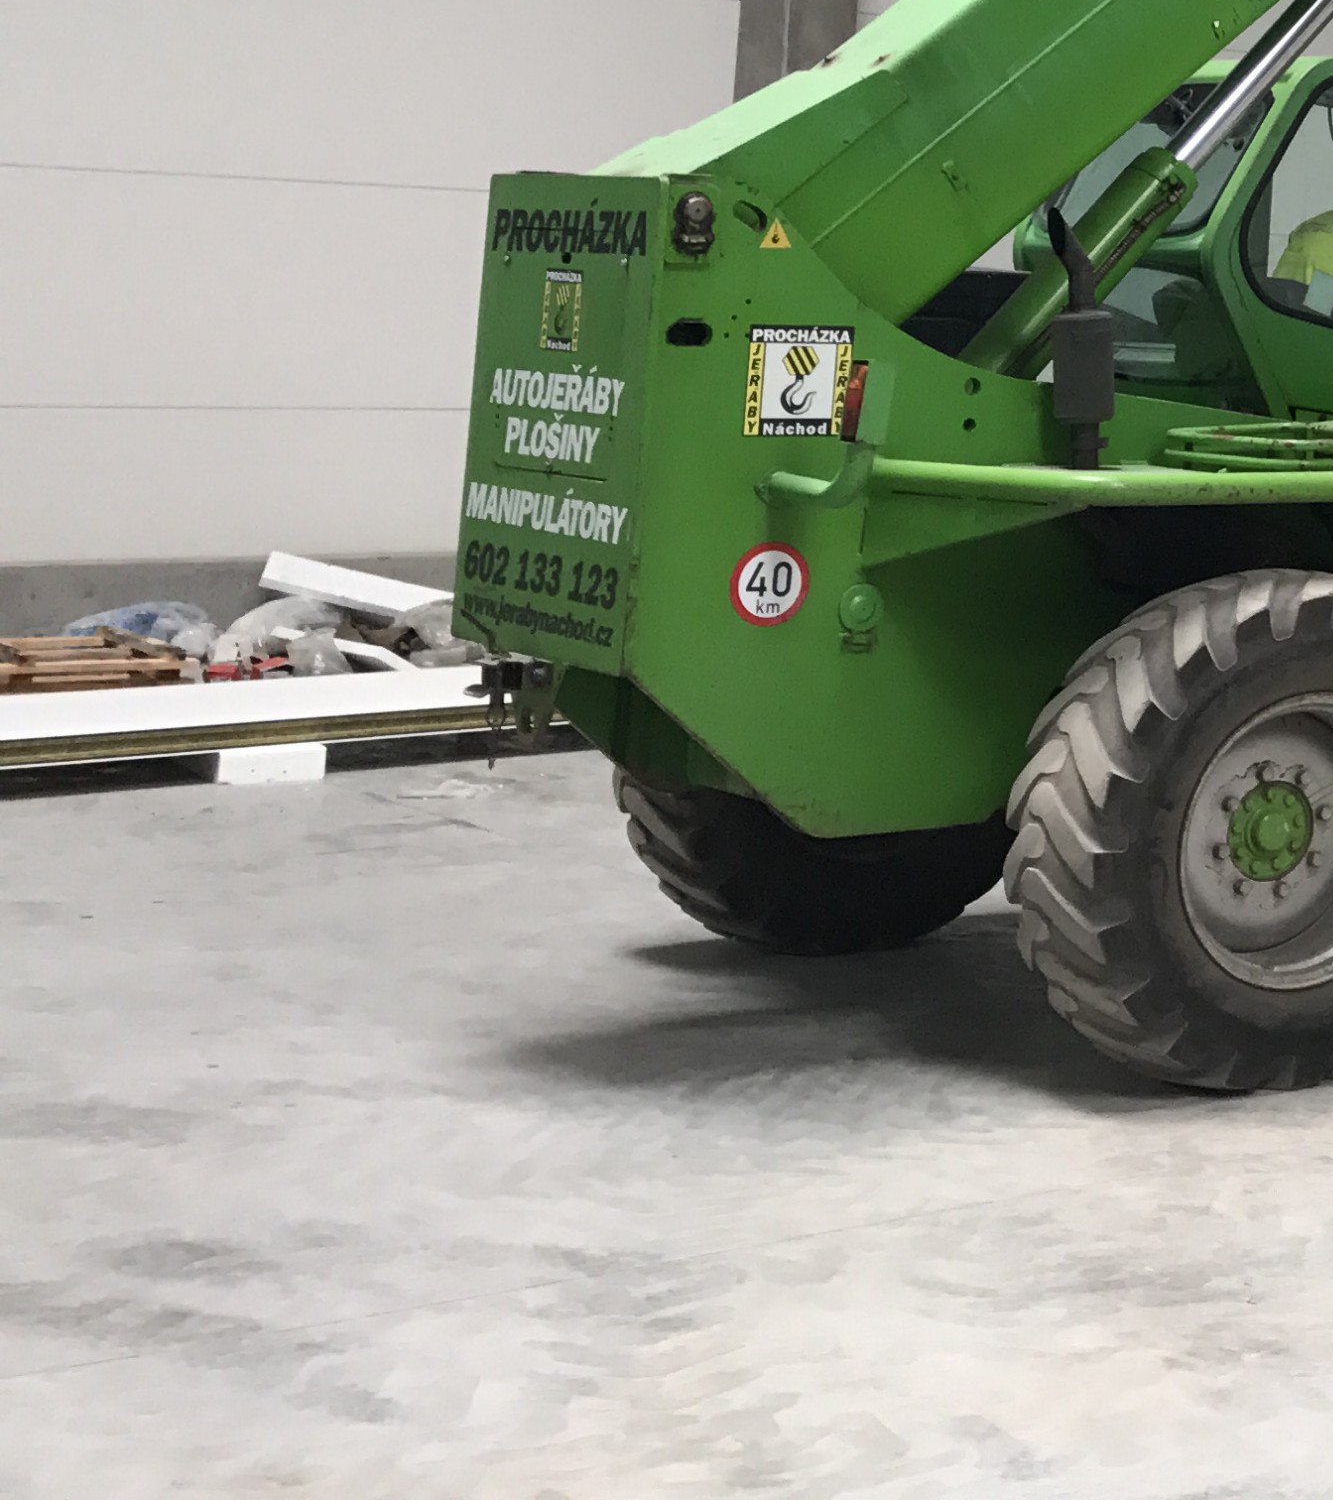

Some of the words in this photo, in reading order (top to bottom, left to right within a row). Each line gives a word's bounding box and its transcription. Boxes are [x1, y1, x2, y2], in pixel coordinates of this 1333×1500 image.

[491, 198, 647, 256] PROCHÁZKA
[752, 326, 851, 343] PROCHÁZKA
[490, 363, 625, 417] AUTOJEŘÁBY
[504, 412, 600, 464] PLOŠINY
[762, 422, 827, 435] Náchod
[466, 481, 628, 545] MANIPULÁTORY
[464, 540, 510, 585] 602
[514, 549, 563, 596] 133
[568, 561, 618, 610] 123
[745, 561, 792, 597] 40
[755, 599, 780, 614] km
